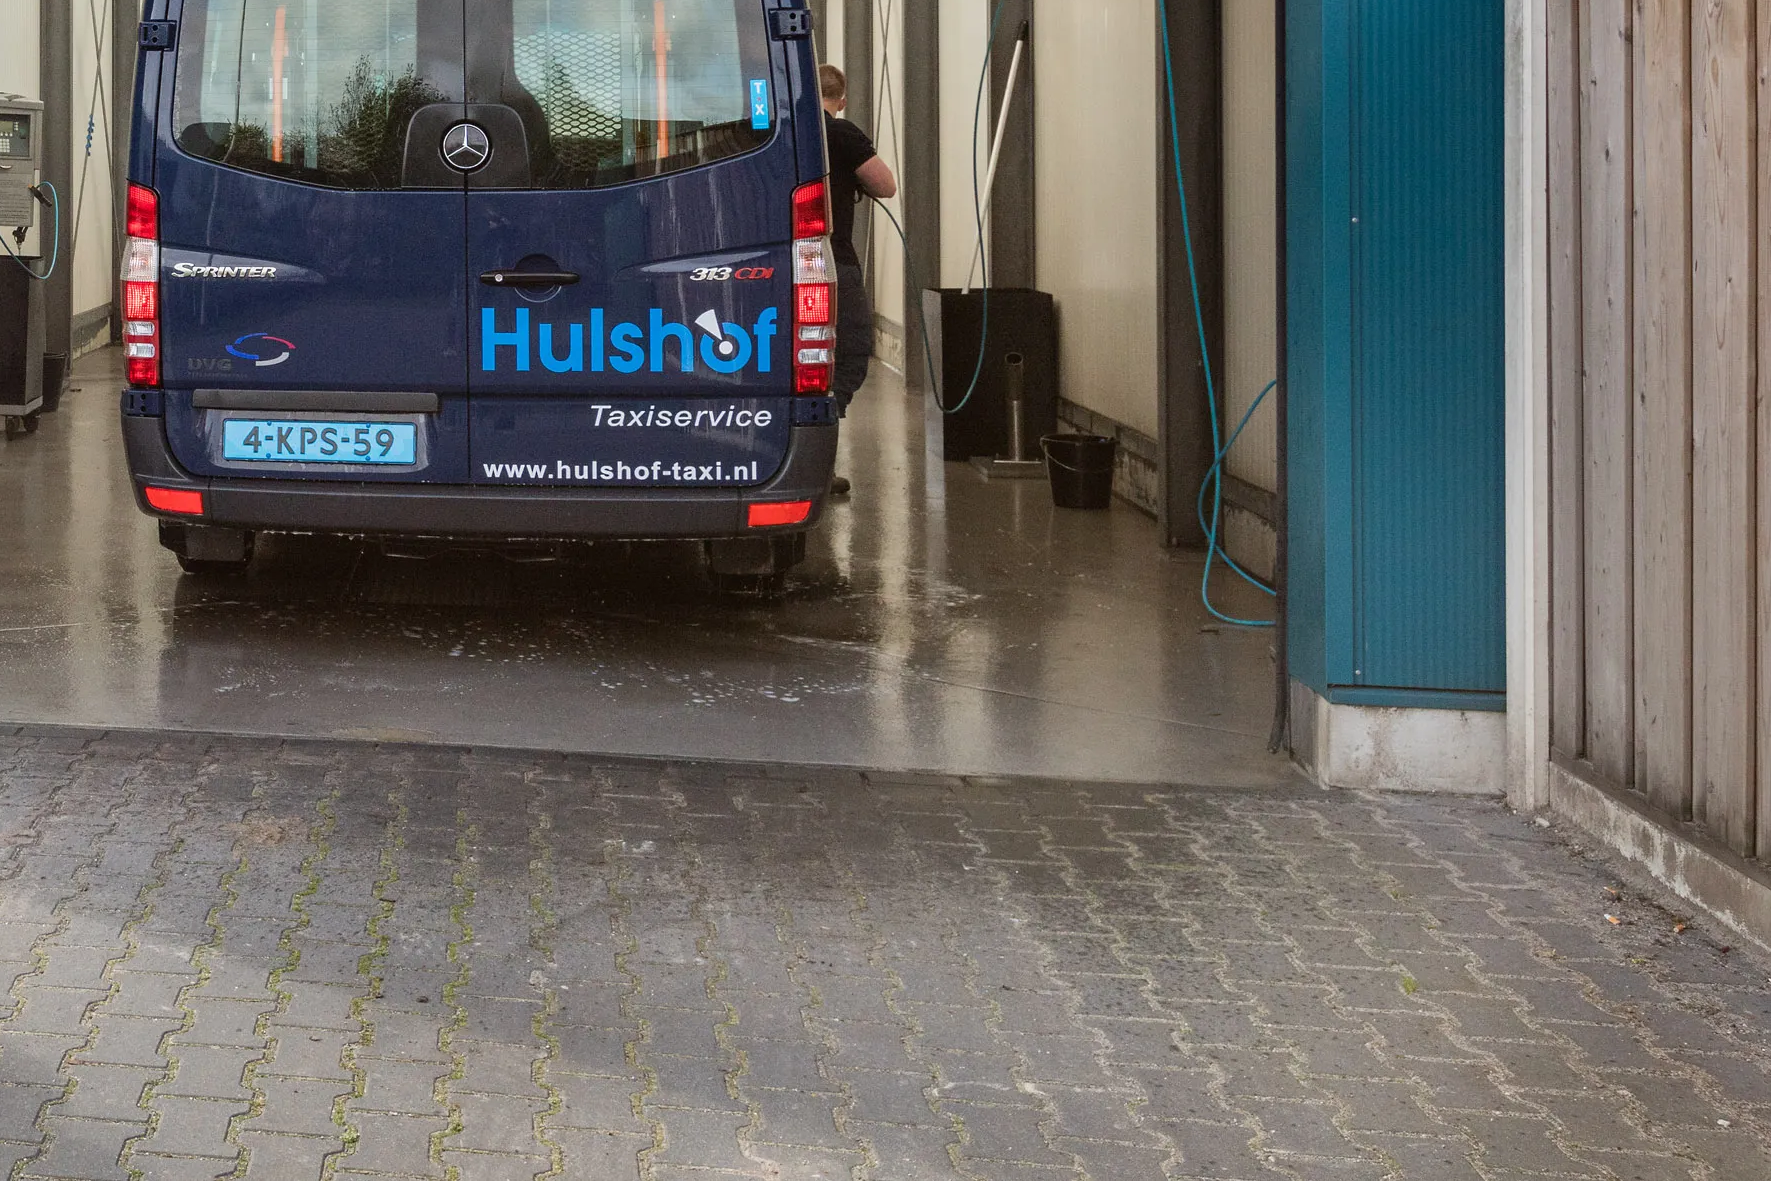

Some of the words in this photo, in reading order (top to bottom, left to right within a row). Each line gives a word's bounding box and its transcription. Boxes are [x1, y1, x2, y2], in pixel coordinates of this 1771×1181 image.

[689, 266, 733, 281] 313
[734, 266, 775, 281] CDI
[481, 306, 778, 374] Hulshof
[590, 404, 773, 427] Taxiservice
[242, 425, 395, 457] 4-KPS-59
[483, 460, 758, 481] www.hulshof-taxi.nl
